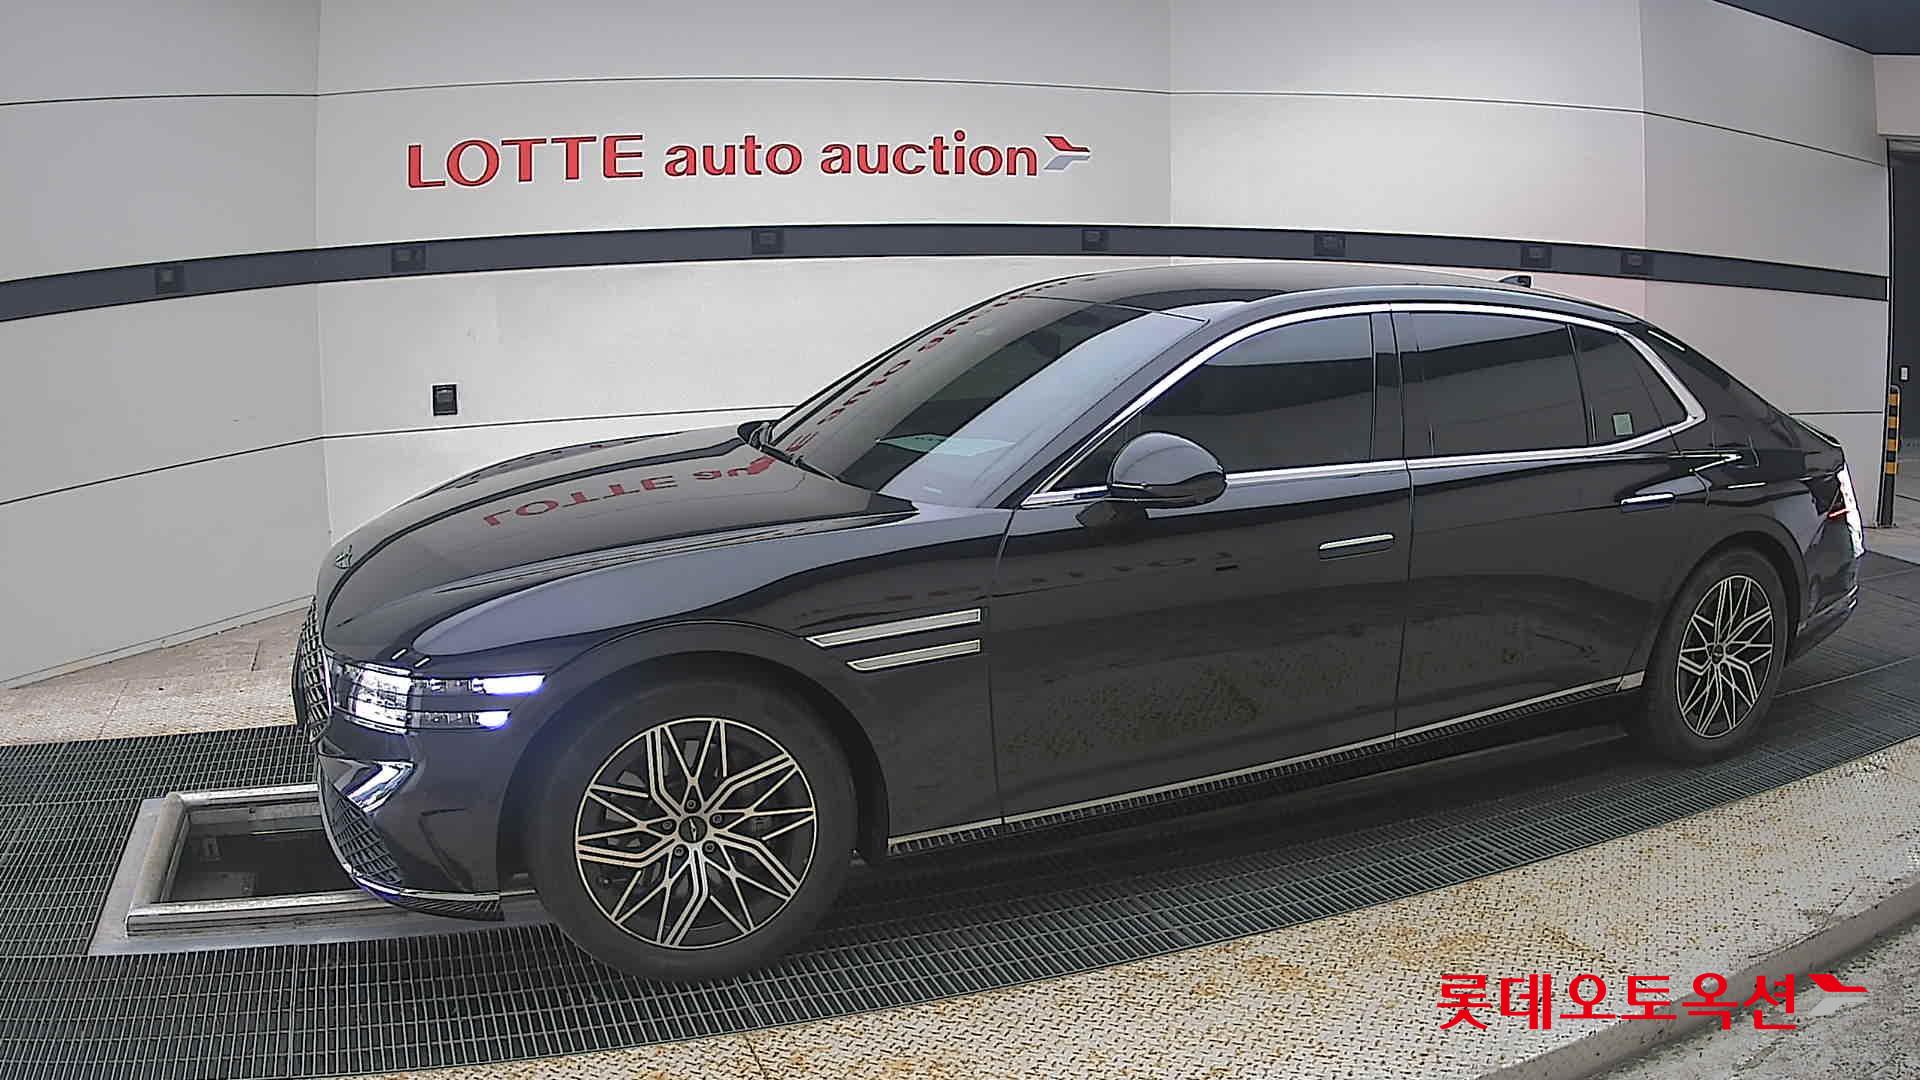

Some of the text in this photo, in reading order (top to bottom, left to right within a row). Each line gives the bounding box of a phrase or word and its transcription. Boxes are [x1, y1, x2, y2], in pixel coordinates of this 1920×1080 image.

[407, 130, 1038, 188] LOTTE auto auction
